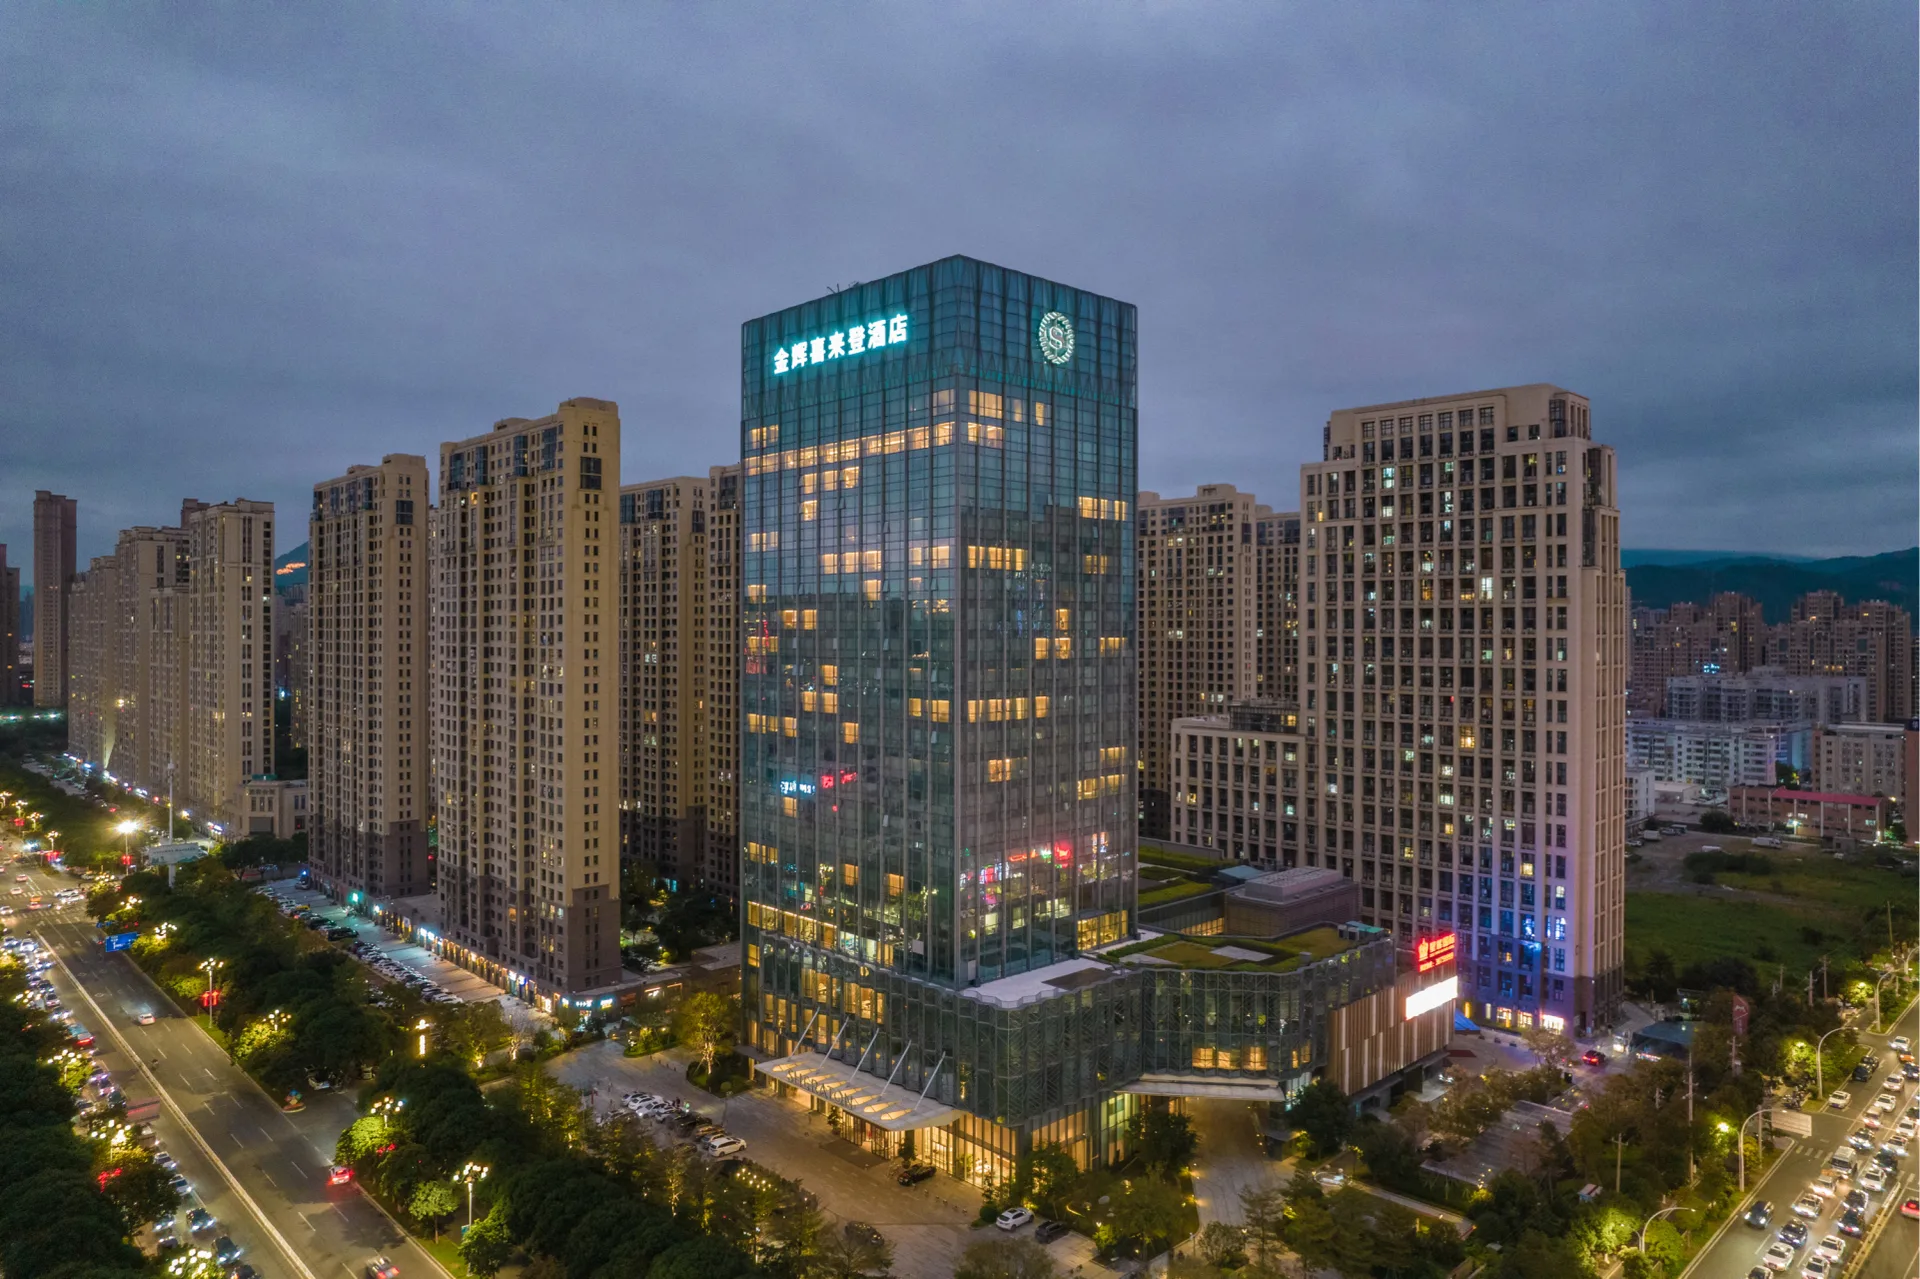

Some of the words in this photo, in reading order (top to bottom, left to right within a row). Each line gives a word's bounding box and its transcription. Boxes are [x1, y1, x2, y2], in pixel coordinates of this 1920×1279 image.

[773, 313, 908, 375] 金辉喜来登酒店
